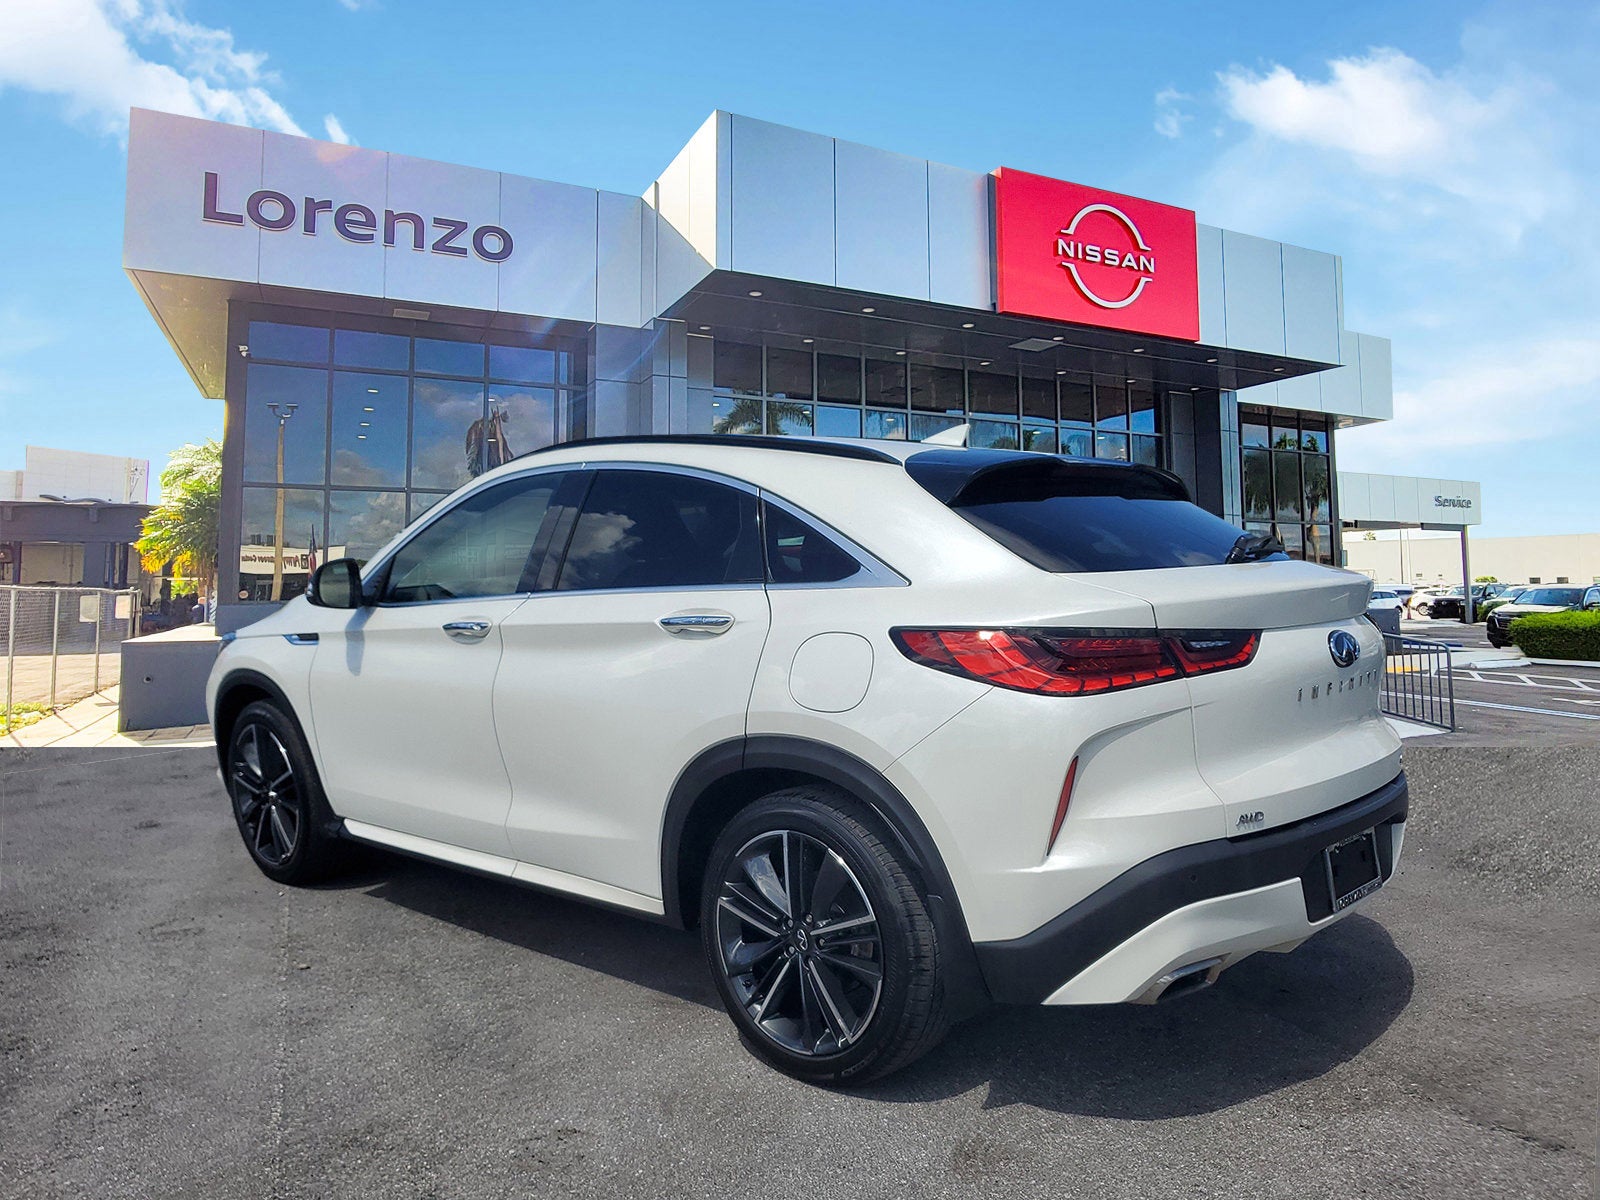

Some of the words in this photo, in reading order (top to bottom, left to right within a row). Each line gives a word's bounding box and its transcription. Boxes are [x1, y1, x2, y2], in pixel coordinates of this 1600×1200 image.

[201, 171, 515, 263] Lorenzo
[1057, 238, 1155, 273] NISSAN
[1434, 495, 1472, 509] Service
[1297, 668, 1377, 702] INFINITI
[1235, 811, 1265, 827] AWD
